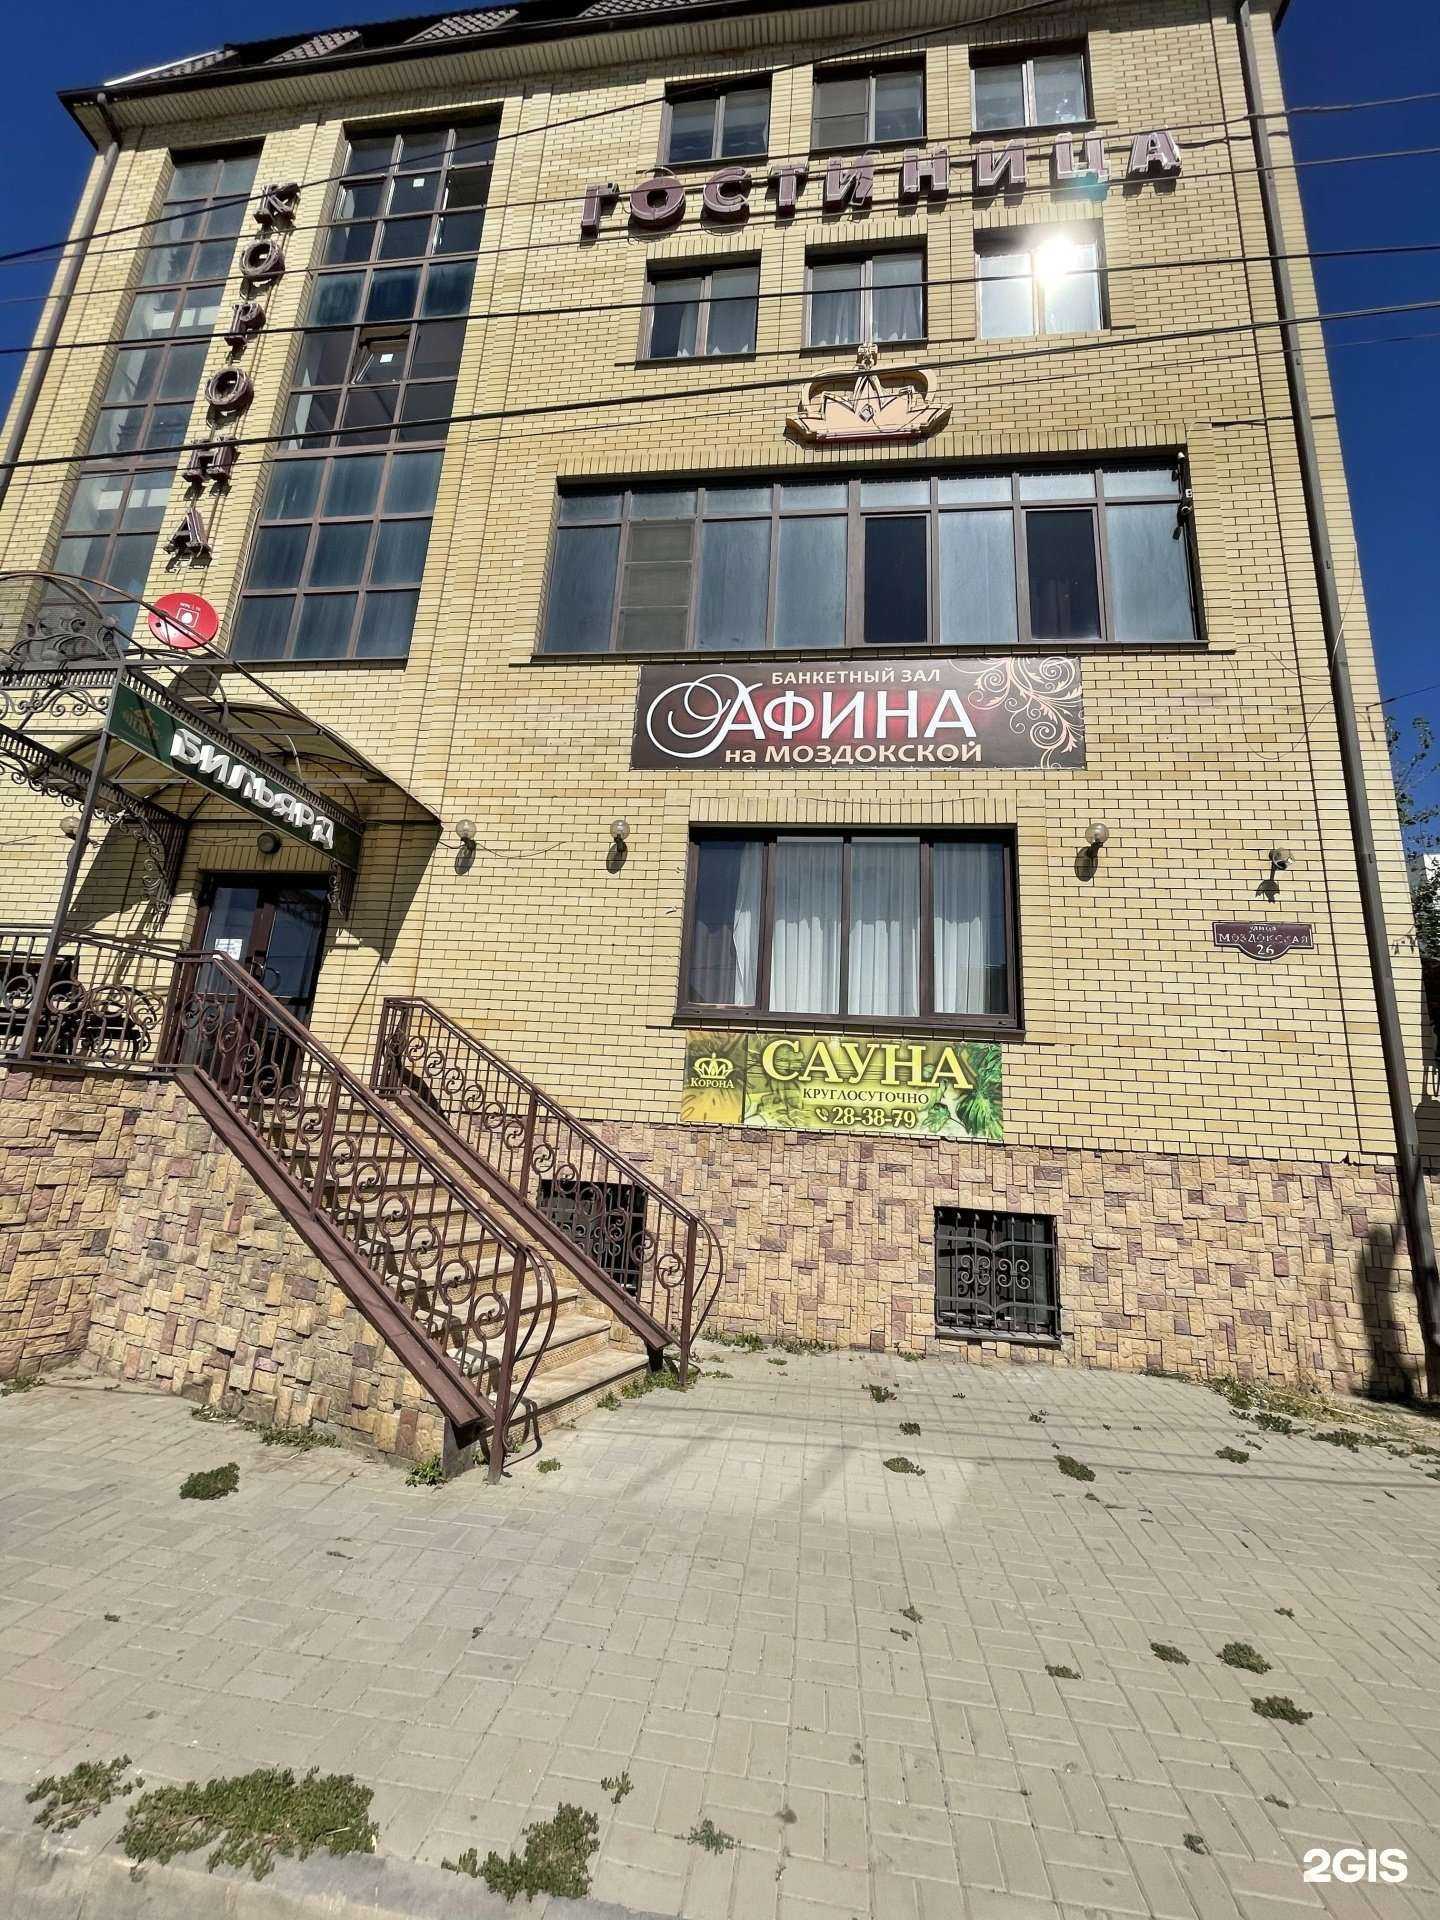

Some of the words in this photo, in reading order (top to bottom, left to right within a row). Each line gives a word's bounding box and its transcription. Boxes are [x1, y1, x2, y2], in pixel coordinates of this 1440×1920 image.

[581, 130, 1183, 234] ГОСТИНИЦА
[163, 181, 301, 560] КОРОНА
[771, 669, 895, 685] БАНКЕТНЫЙ
[901, 668, 941, 682] ЗАЛ
[646, 673, 977, 759] АФИНА
[725, 747, 756, 763] на
[764, 741, 982, 765] МОЗДОКСКОЙ
[1256, 944, 1275, 955] 26
[761, 1038, 974, 1090] САУНА
[690, 1076, 735, 1089] КОРОНА
[802, 1087, 930, 1105] КРУГЛОСУТОЧНО
[832, 1106, 917, 1129] 28-38-79
